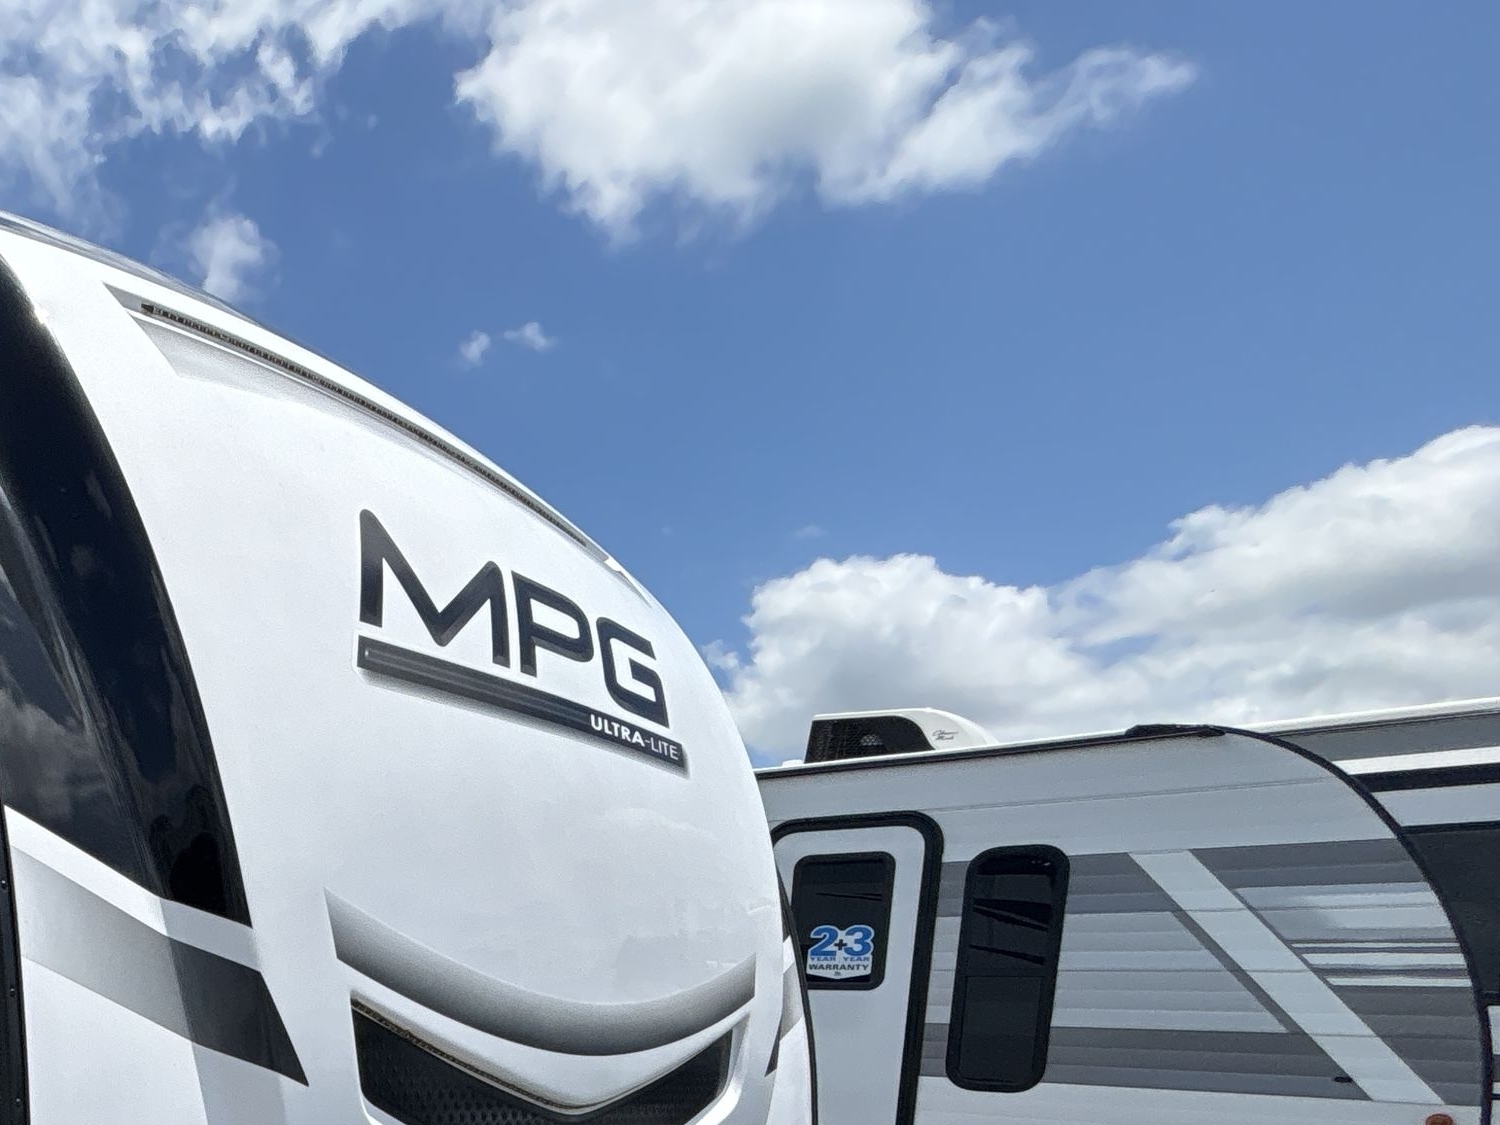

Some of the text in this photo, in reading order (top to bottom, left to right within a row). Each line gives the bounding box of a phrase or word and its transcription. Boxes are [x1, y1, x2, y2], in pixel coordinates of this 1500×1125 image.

[359, 508, 670, 729] MPG
[589, 713, 681, 762] ULTRA-LITE
[809, 963, 869, 971] WARRANTY
